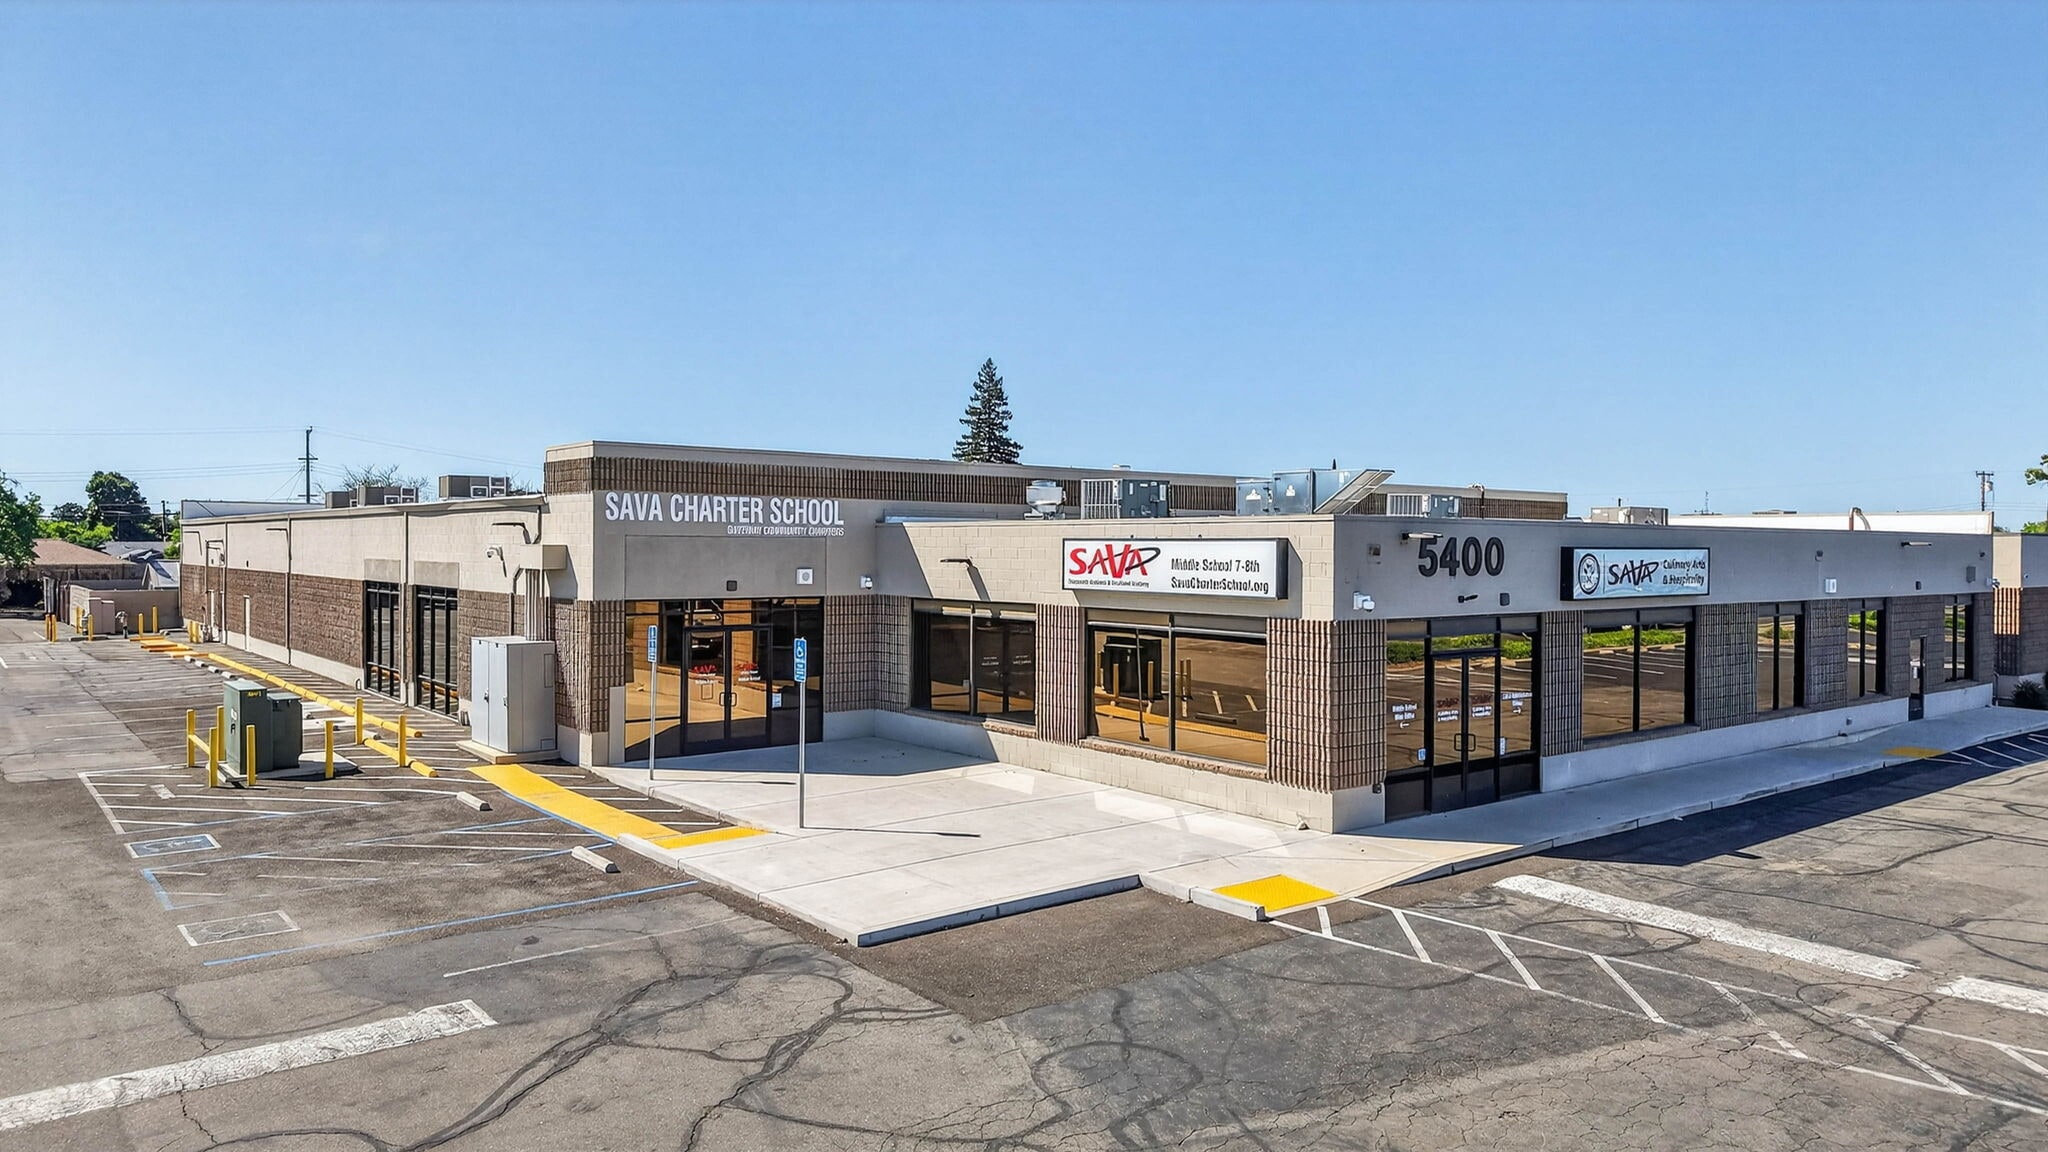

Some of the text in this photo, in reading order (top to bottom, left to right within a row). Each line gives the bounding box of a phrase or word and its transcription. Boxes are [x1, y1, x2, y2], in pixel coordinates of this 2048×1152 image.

[605, 492, 844, 525] SAVA CHARTER SCHOOL
[1069, 544, 1161, 578] SAVA
[1171, 558, 1260, 573] Middle School 7-8th
[1418, 537, 1504, 577] 5400
[1607, 559, 1659, 586] SAVA
